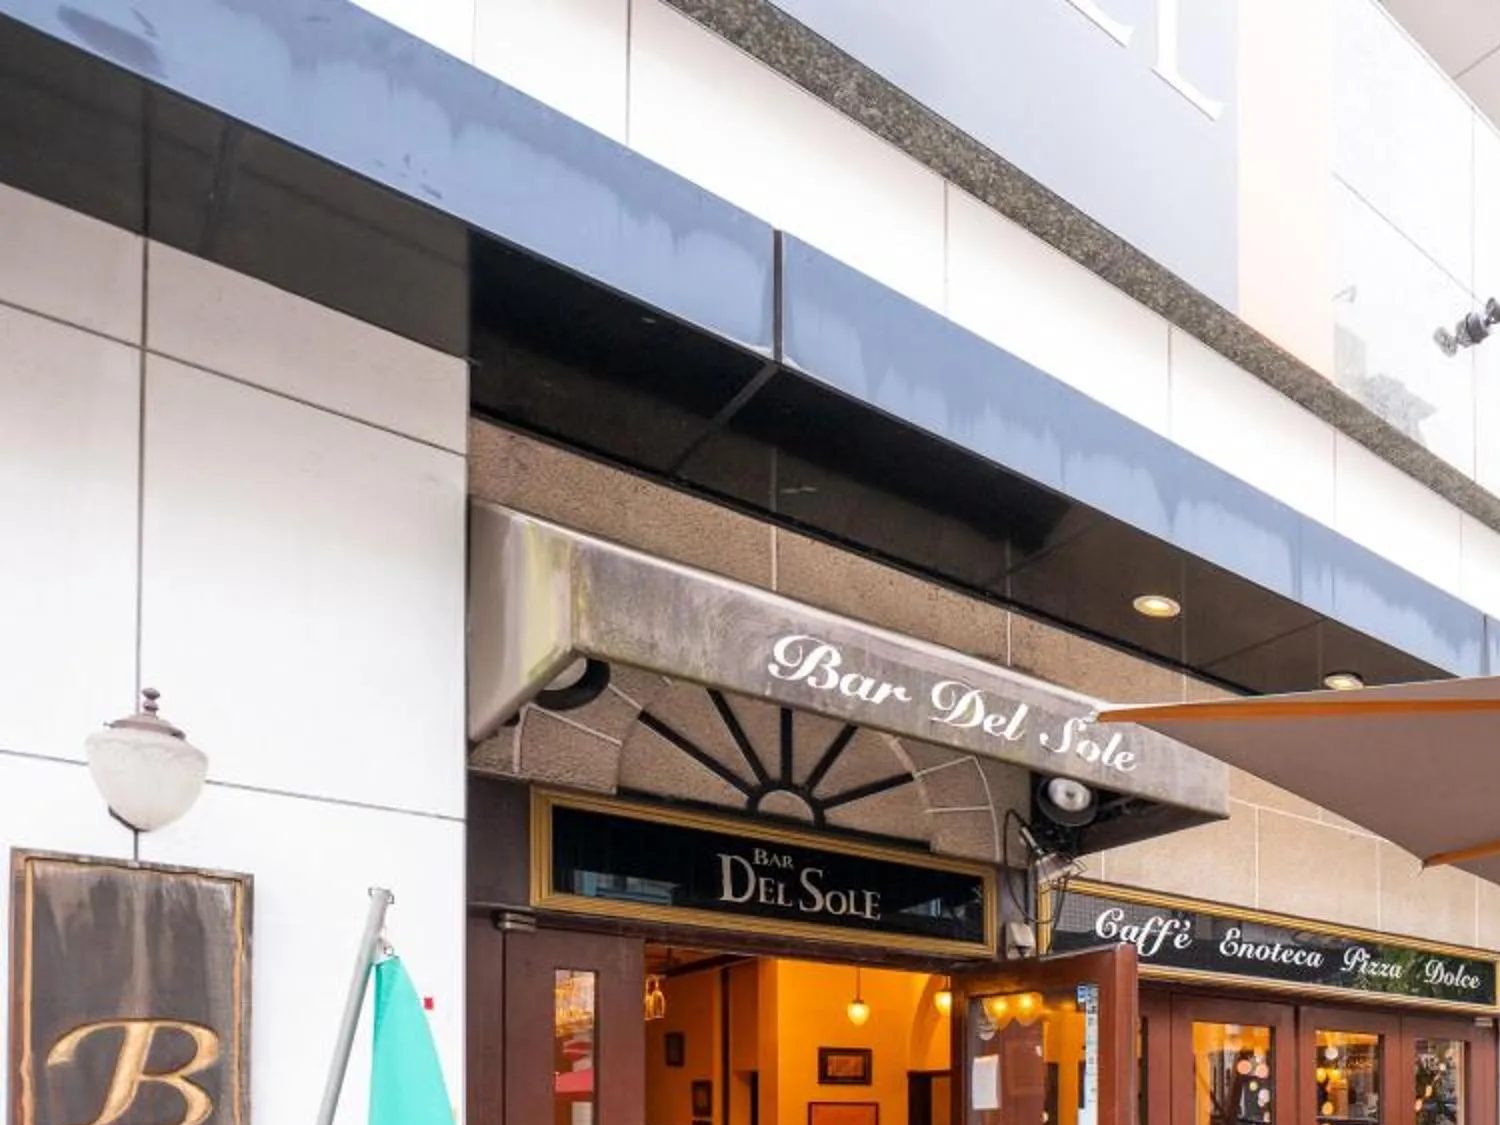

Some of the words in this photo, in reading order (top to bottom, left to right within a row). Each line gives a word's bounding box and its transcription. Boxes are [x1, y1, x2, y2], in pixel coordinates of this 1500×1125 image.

[768, 635, 911, 704] Bar
[929, 680, 1029, 741] Del
[1040, 711, 1137, 772] Sole
[1219, 928, 1324, 968] Enoteca
[1340, 946, 1403, 983] Pizza
[1424, 959, 1481, 989] Dolce
